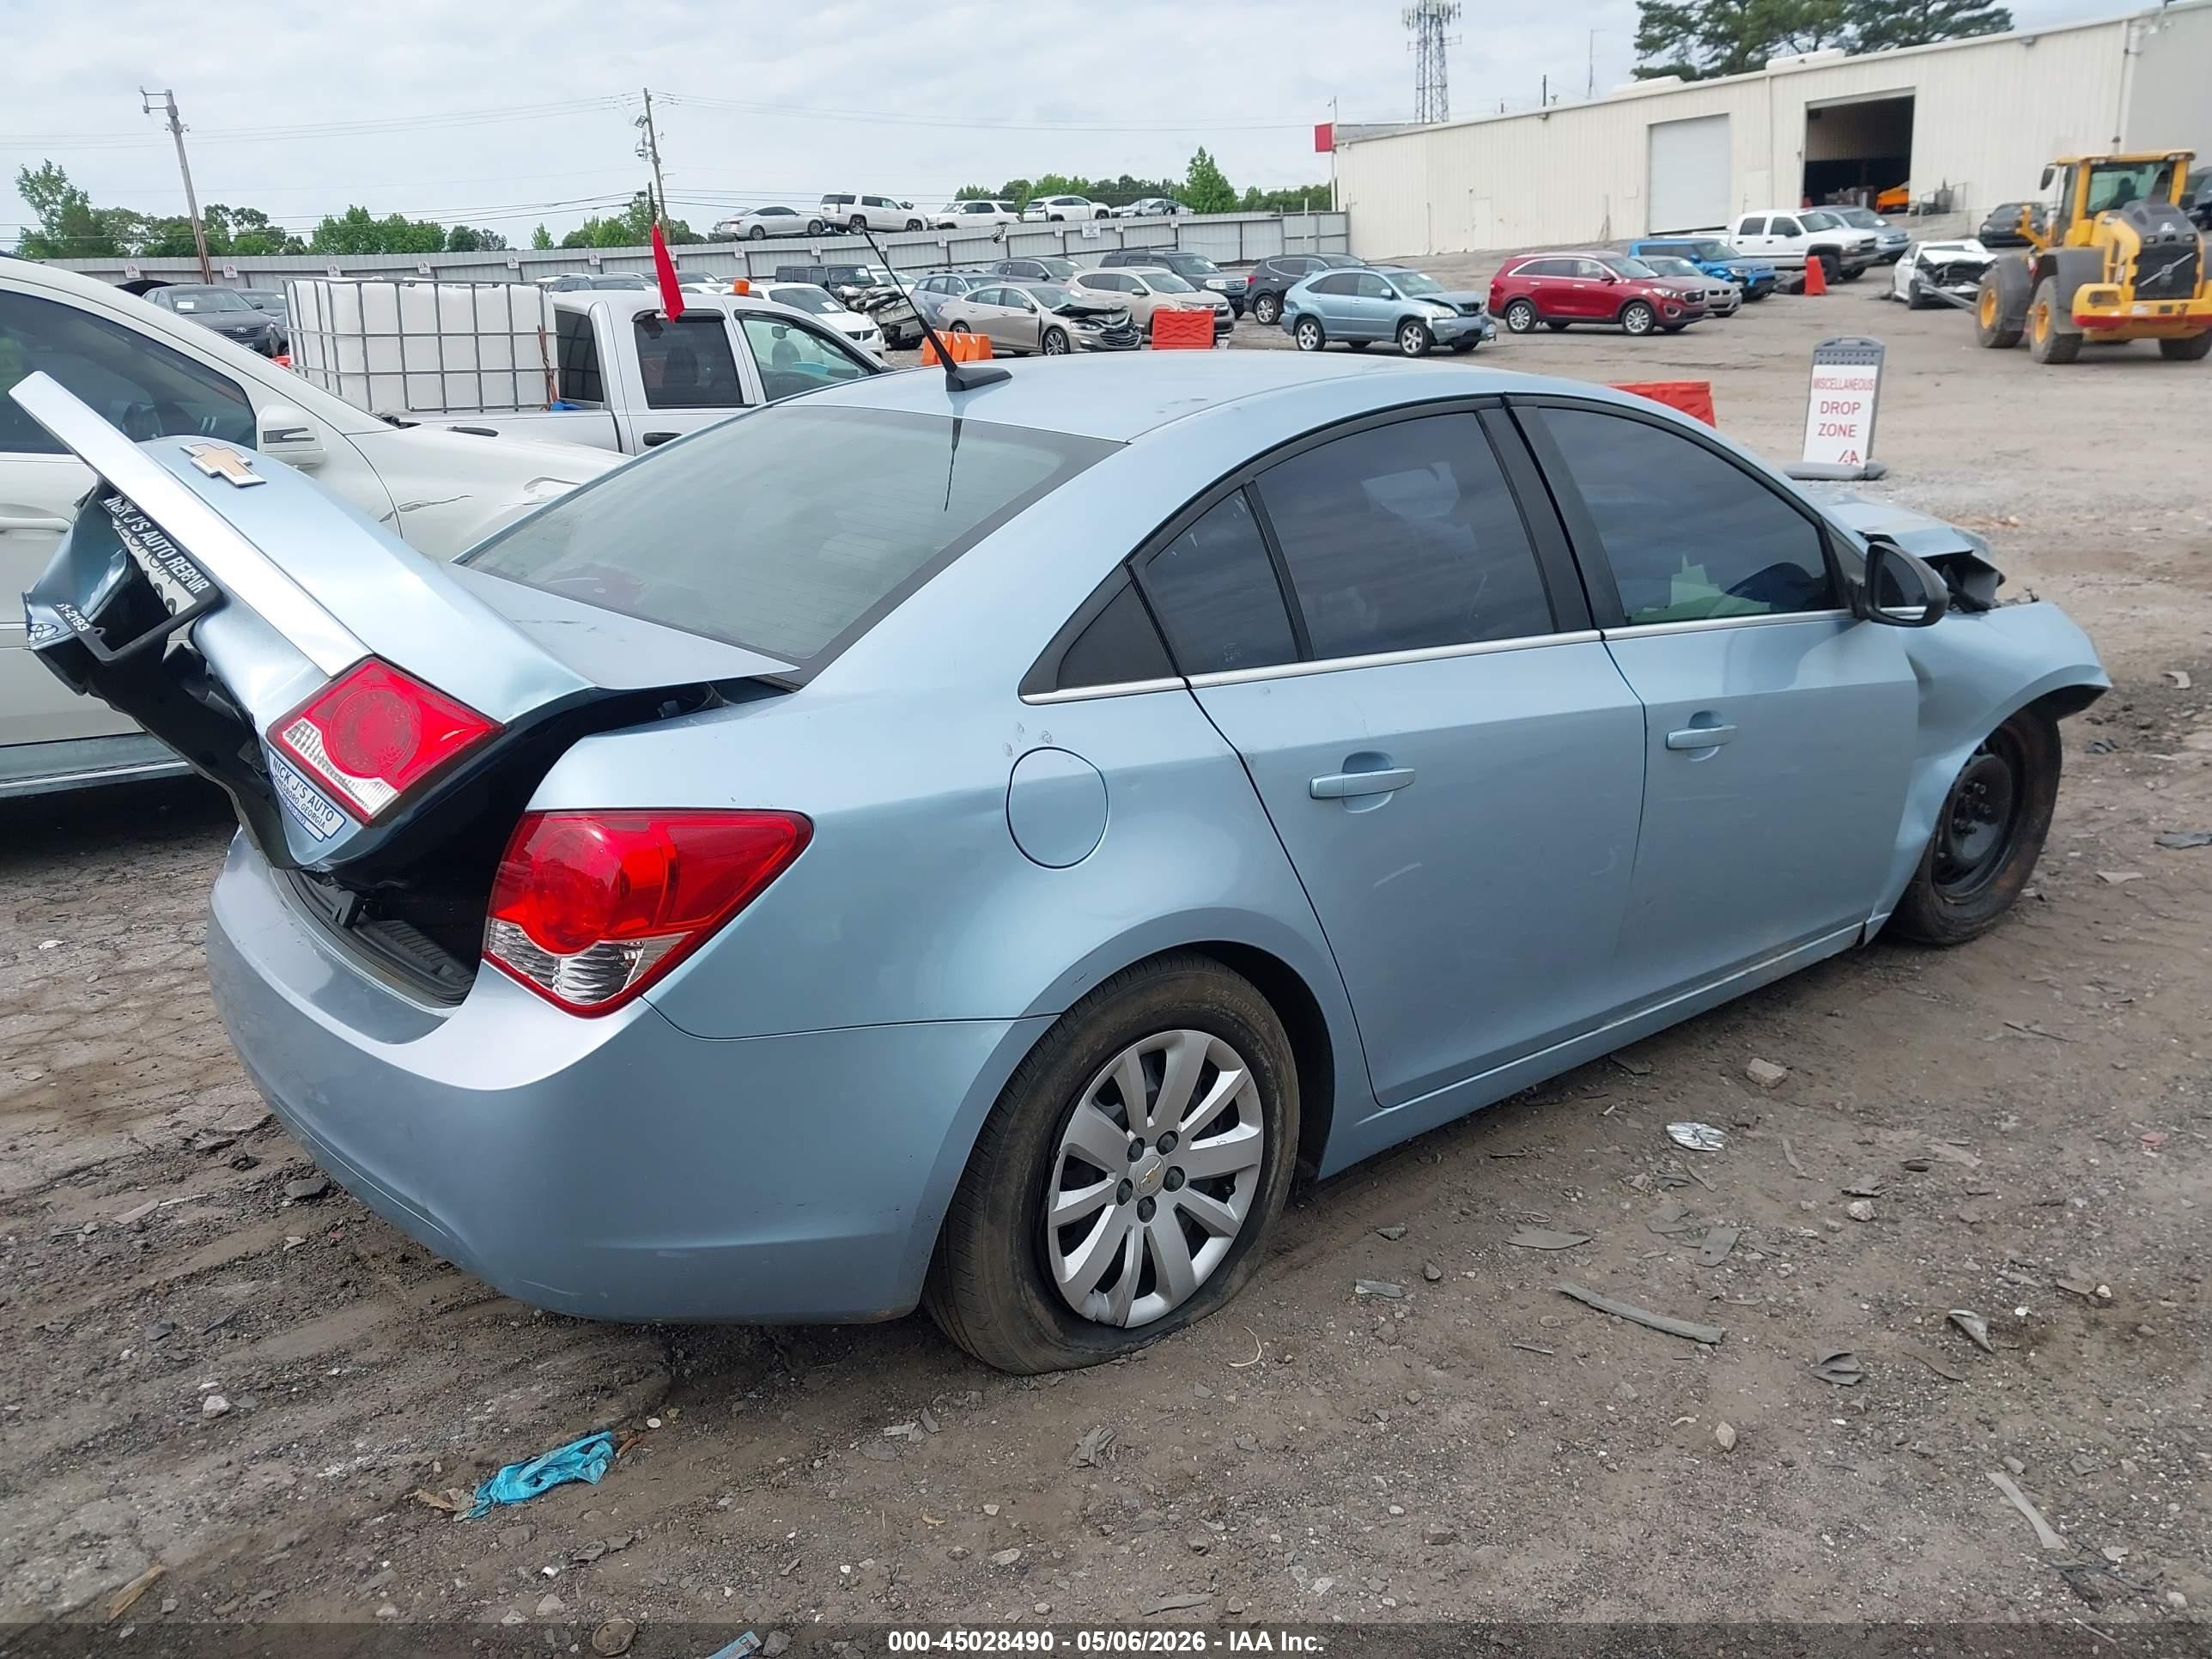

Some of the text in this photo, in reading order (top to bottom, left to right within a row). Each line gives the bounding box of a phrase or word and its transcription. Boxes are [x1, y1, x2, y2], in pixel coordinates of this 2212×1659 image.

[1813, 377, 1875, 391] MISCELLANEOUS
[1820, 401, 1861, 415] DROP
[1818, 423, 1857, 438] ZONE
[123, 515, 151, 532] J'S
[137, 530, 177, 559] AUTO
[272, 759, 335, 822] NICK J'S AUTO
[301, 803, 326, 830] GEORGIA
